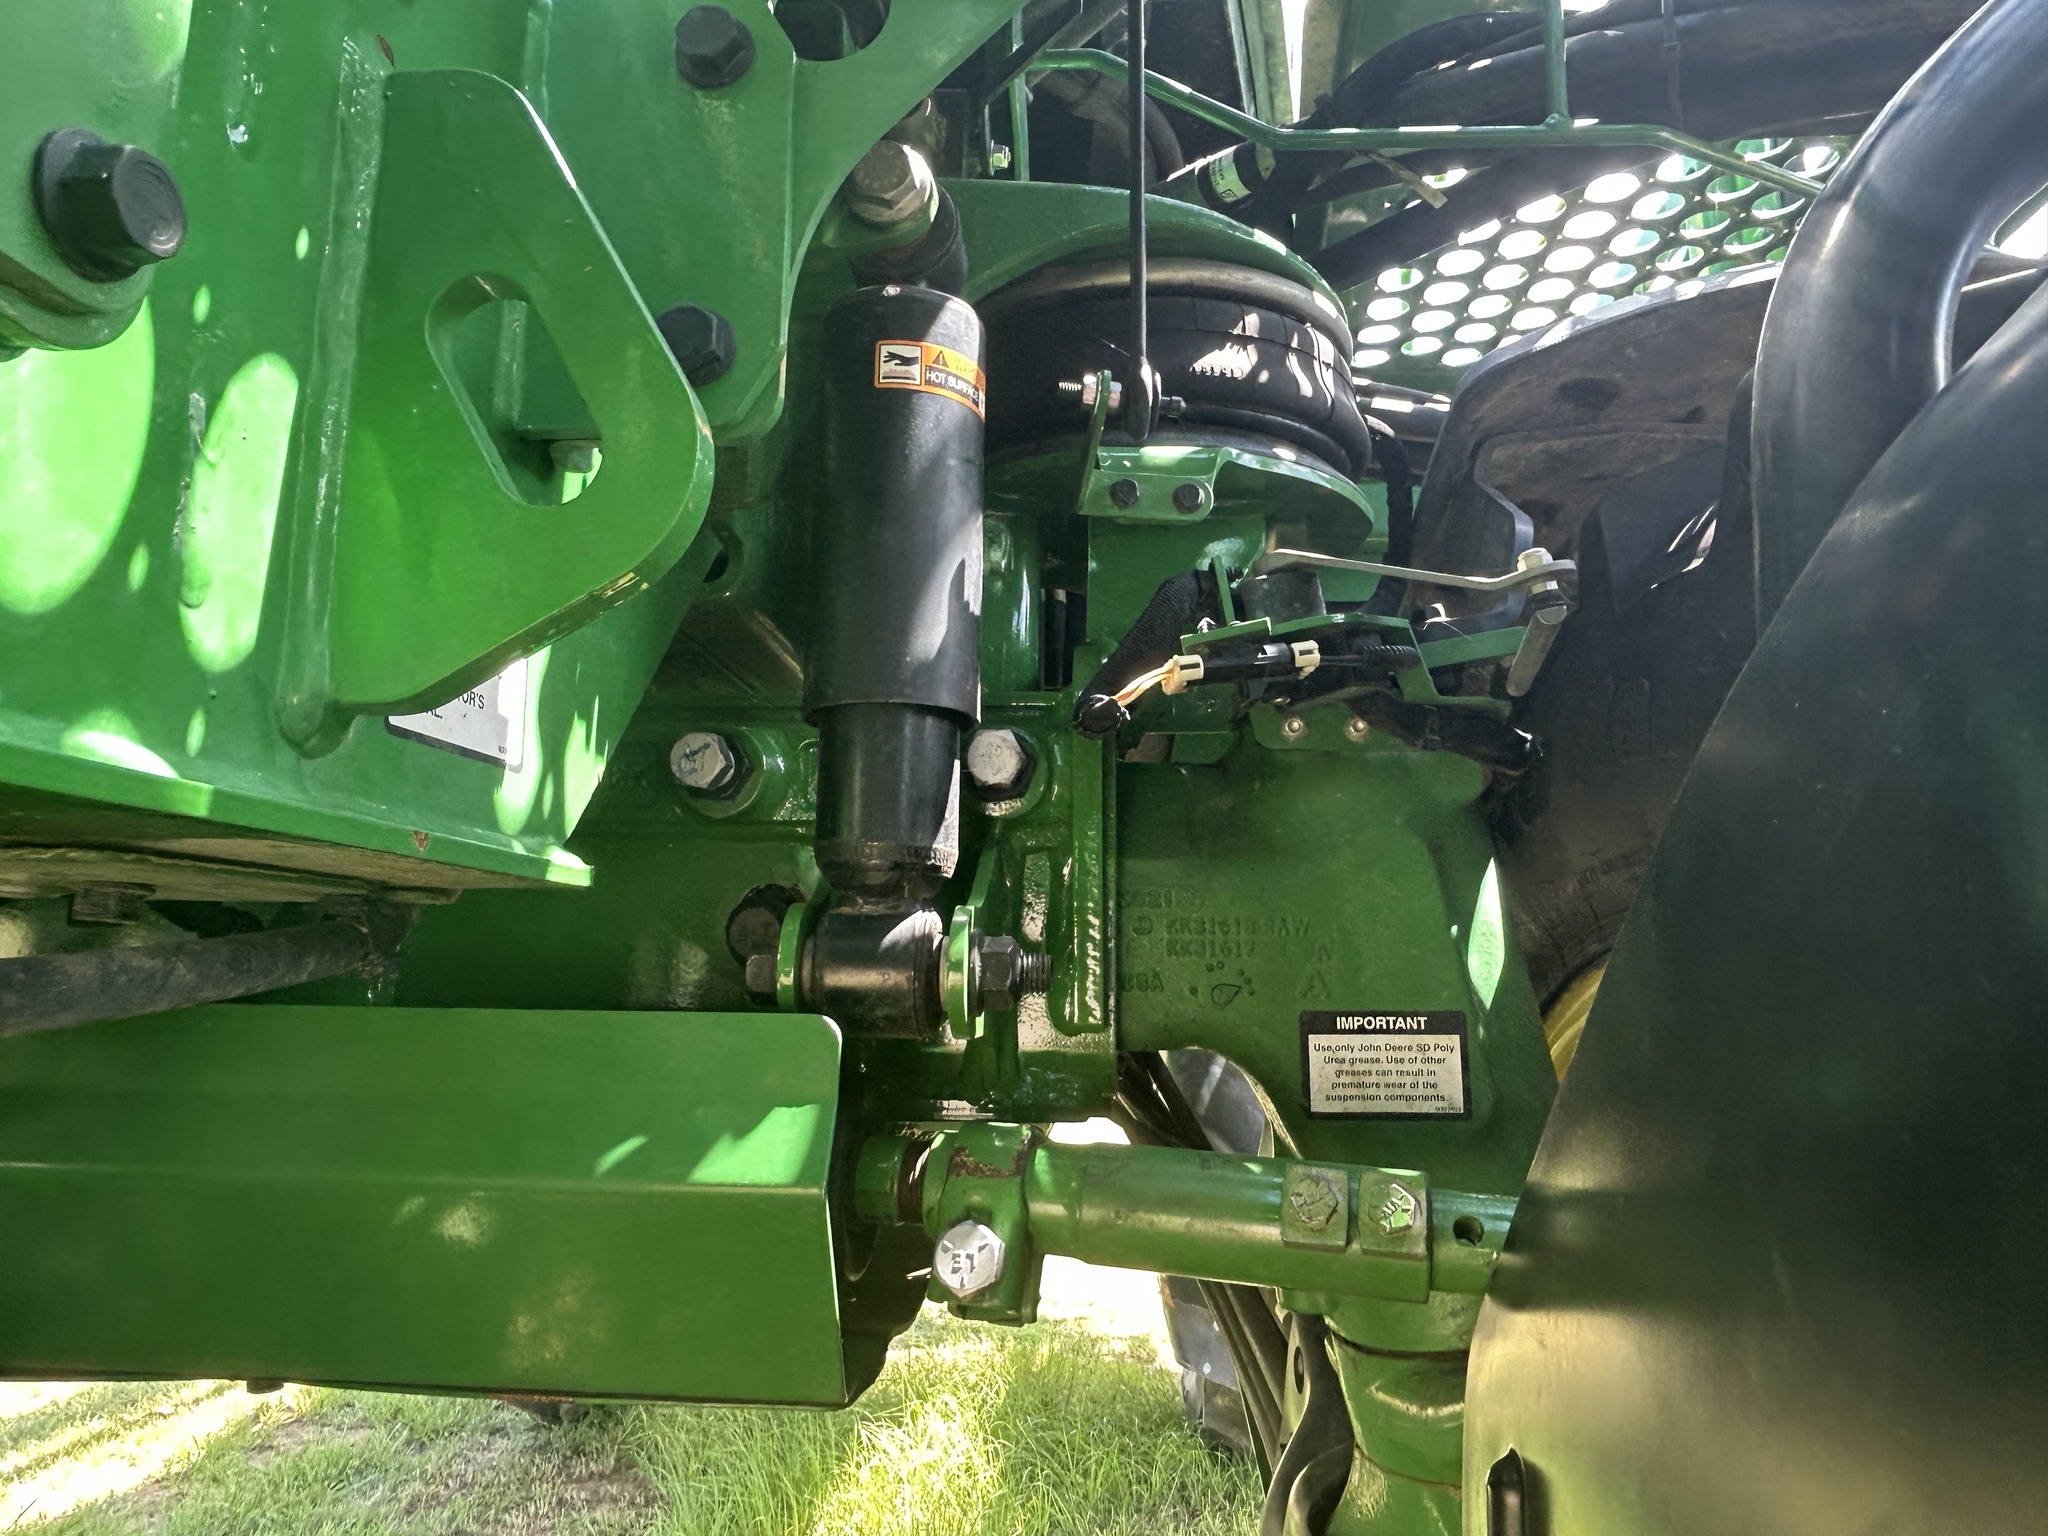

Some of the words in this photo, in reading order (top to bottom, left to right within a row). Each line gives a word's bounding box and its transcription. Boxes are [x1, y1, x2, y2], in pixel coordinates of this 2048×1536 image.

[926, 369, 947, 385] HOT
[1336, 1016, 1427, 1030] IMPORTANT
[1335, 1044, 1354, 1053] only
[1358, 1043, 1381, 1052] John
[1385, 1043, 1413, 1052] Deere
[1416, 1044, 1431, 1052] SD
[1434, 1043, 1454, 1053] Poly
[1324, 1056, 1346, 1064] Urea
[1349, 1056, 1384, 1066] grease.
[1386, 1056, 1404, 1064] Use
[1408, 1056, 1418, 1064] of
[1421, 1056, 1446, 1064] other
[1335, 1069, 1372, 1079] greases
[1376, 1069, 1393, 1077] can
[1396, 1068, 1424, 1077] result
[1427, 1068, 1436, 1076] in
[1332, 1081, 1380, 1091] premature
[1410, 1081, 1419, 1089] of
[1422, 1081, 1438, 1089] the
[1326, 1093, 1381, 1103] suspension
[1384, 1094, 1449, 1102] components.
